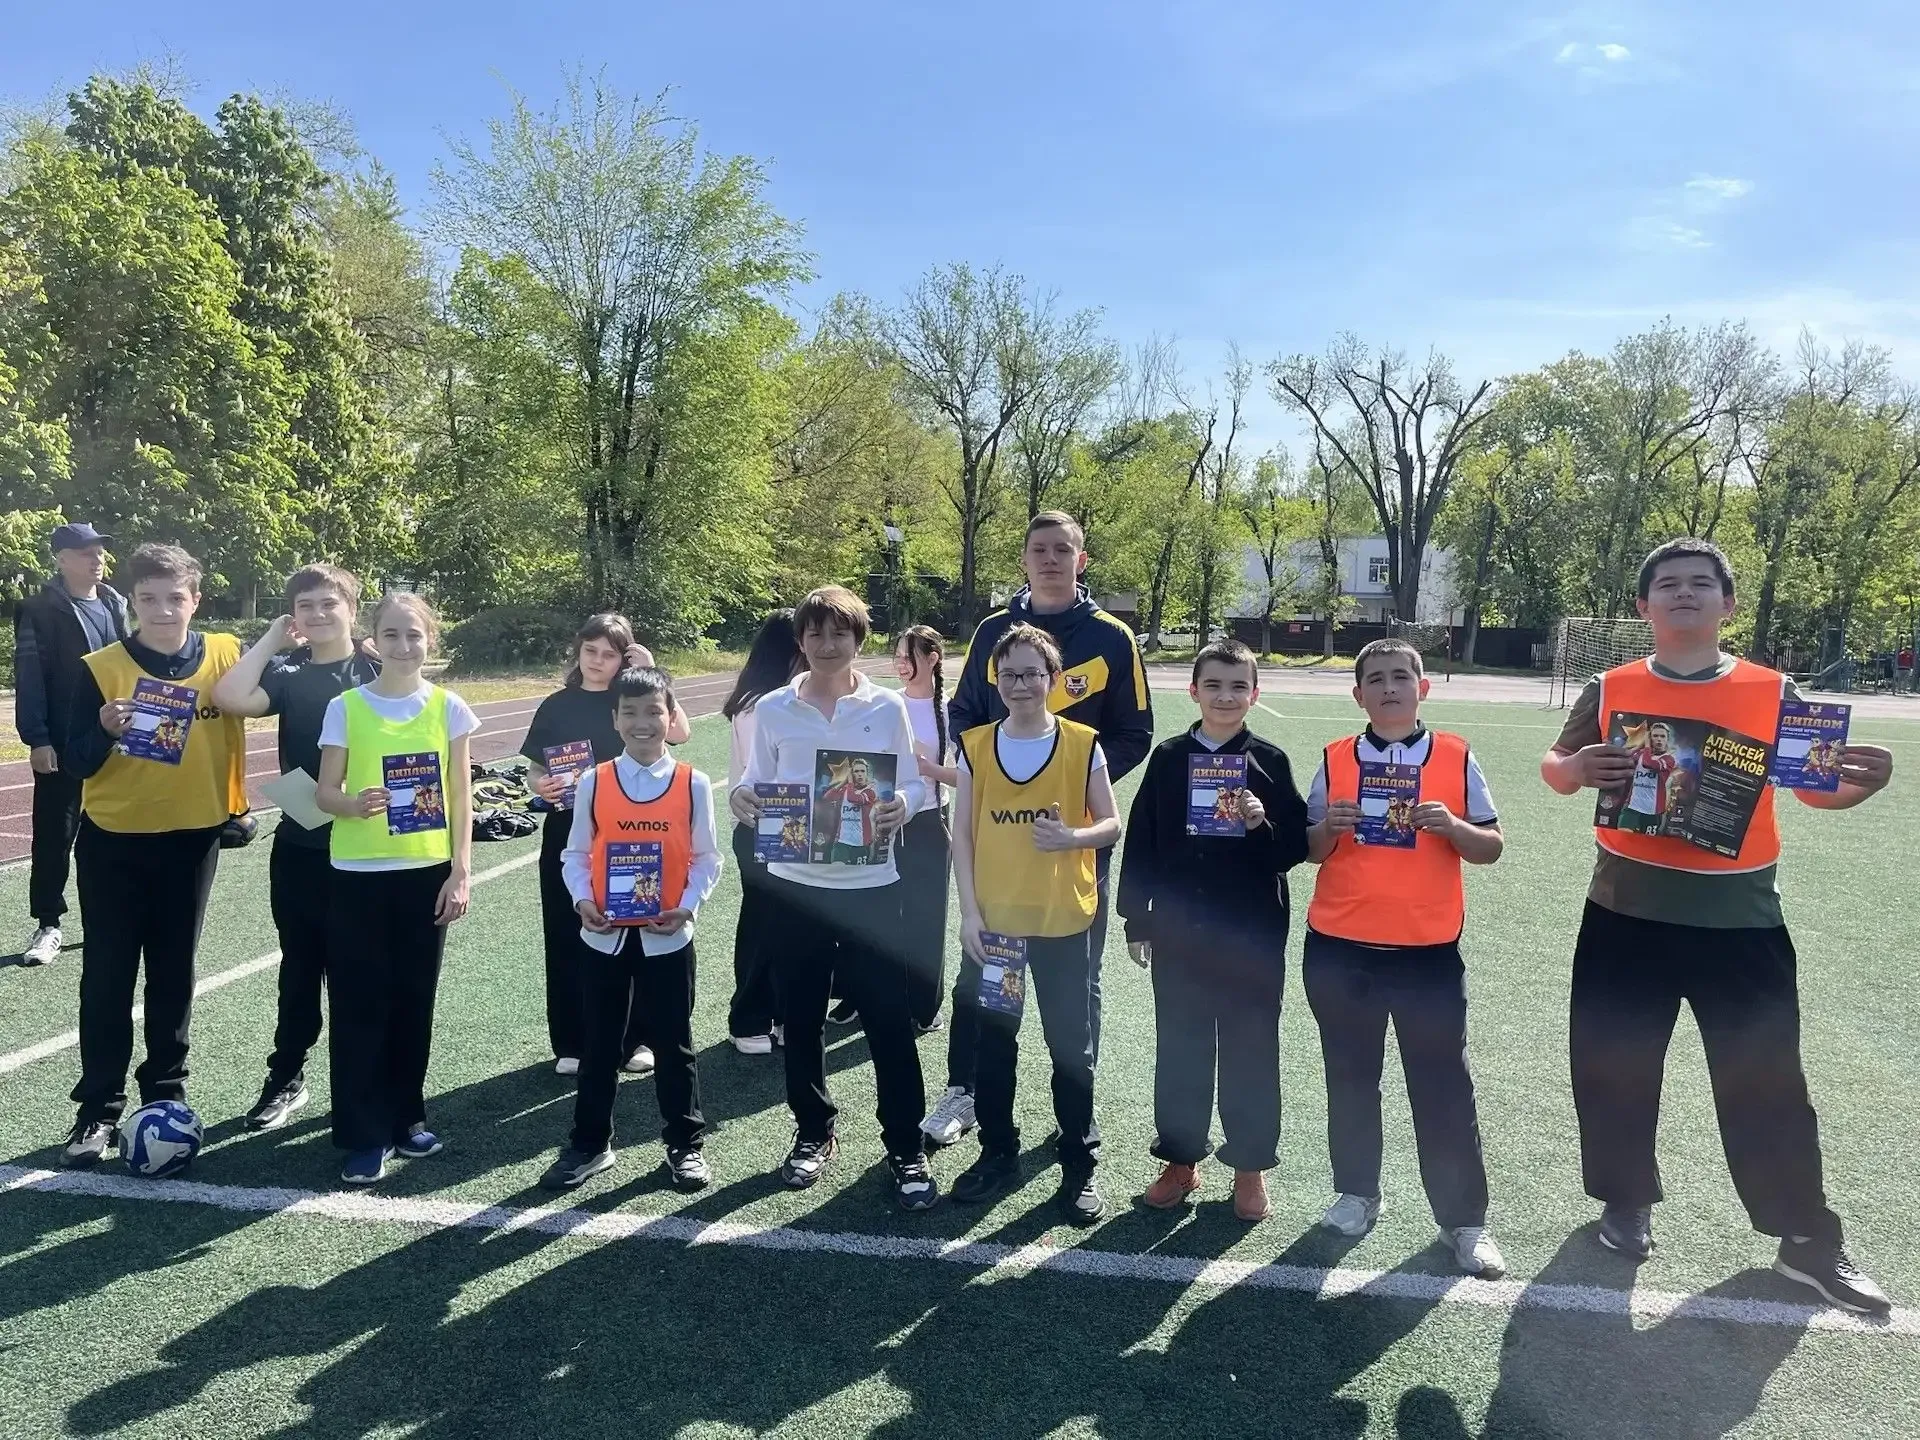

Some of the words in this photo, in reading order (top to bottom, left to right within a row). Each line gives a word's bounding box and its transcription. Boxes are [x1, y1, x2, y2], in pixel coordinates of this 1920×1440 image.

[1781, 715, 1844, 729] ДИПЛОМ
[1705, 734, 1765, 762] АЛЕКСЕЙ
[1703, 746, 1766, 777] БАТРАКОВ
[387, 765, 437, 780] ДИПЛОМ
[1192, 768, 1243, 778] ДИПЛОМ
[1362, 776, 1417, 789] ДИПЛОМ
[990, 808, 1050, 824] VAMO
[617, 820, 669, 832] VAMOS
[610, 855, 659, 866] ДИПЛОМ
